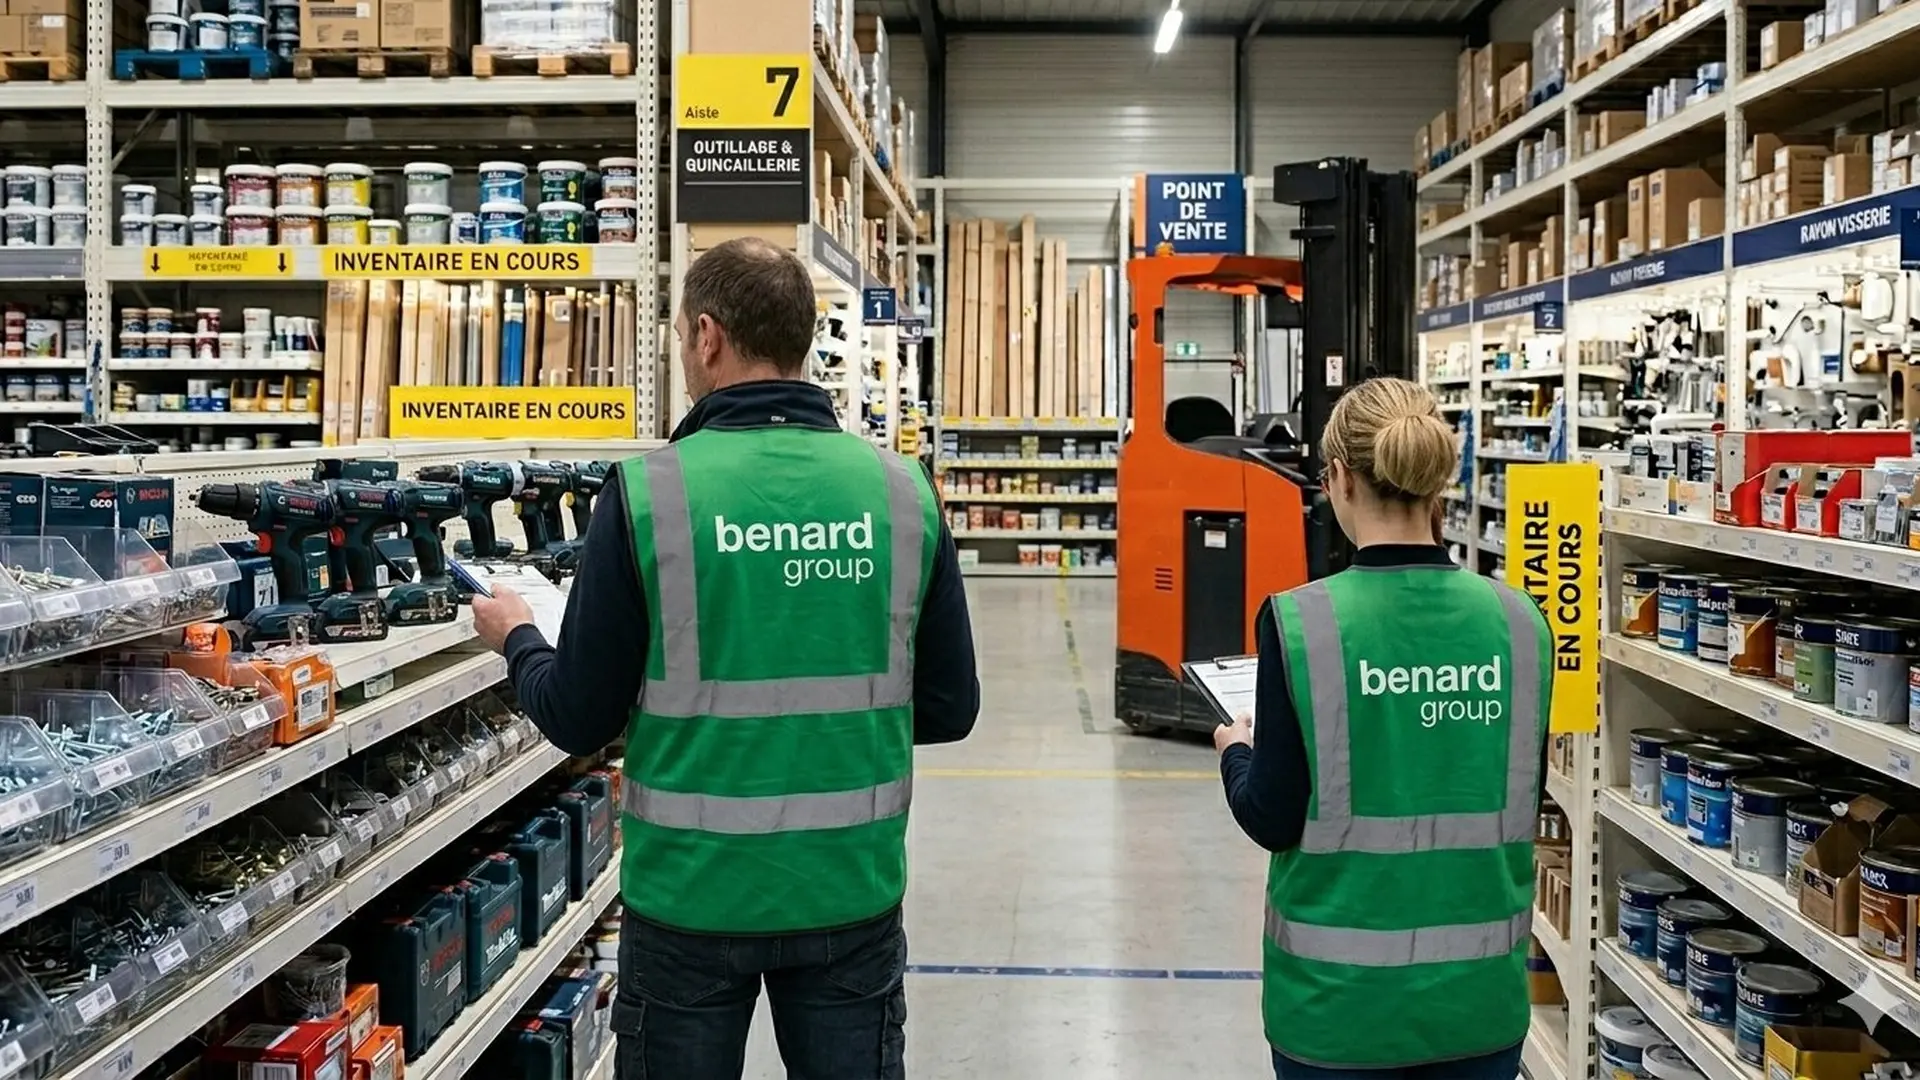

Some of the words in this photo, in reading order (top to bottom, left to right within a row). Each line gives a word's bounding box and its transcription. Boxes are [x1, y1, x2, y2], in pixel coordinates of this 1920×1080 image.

[766, 66, 800, 118] 7
[684, 106, 720, 119] Aiste
[781, 140, 793, 155] &
[685, 157, 801, 173] QUINCAILLERIE
[1162, 181, 1226, 200] POINT
[1180, 201, 1207, 219] DE
[1159, 221, 1227, 241] VENTE
[1800, 218, 1837, 244] RAYON
[1837, 205, 1891, 234] VISSERIE
[334, 252, 463, 271] INVENTAIRE
[471, 252, 499, 271] EN
[506, 251, 580, 271] COURS
[873, 301, 882, 319] 1
[1544, 313, 1555, 328] 2
[402, 402, 520, 419] INVENTAIRE
[526, 402, 551, 419] EN
[557, 402, 626, 420] COURS
[714, 512, 873, 553] benard
[783, 557, 875, 588] group
[1557, 522, 1583, 625] COURS
[1557, 633, 1582, 672] EN
[1359, 655, 1502, 696] benard
[1419, 699, 1502, 728] group
